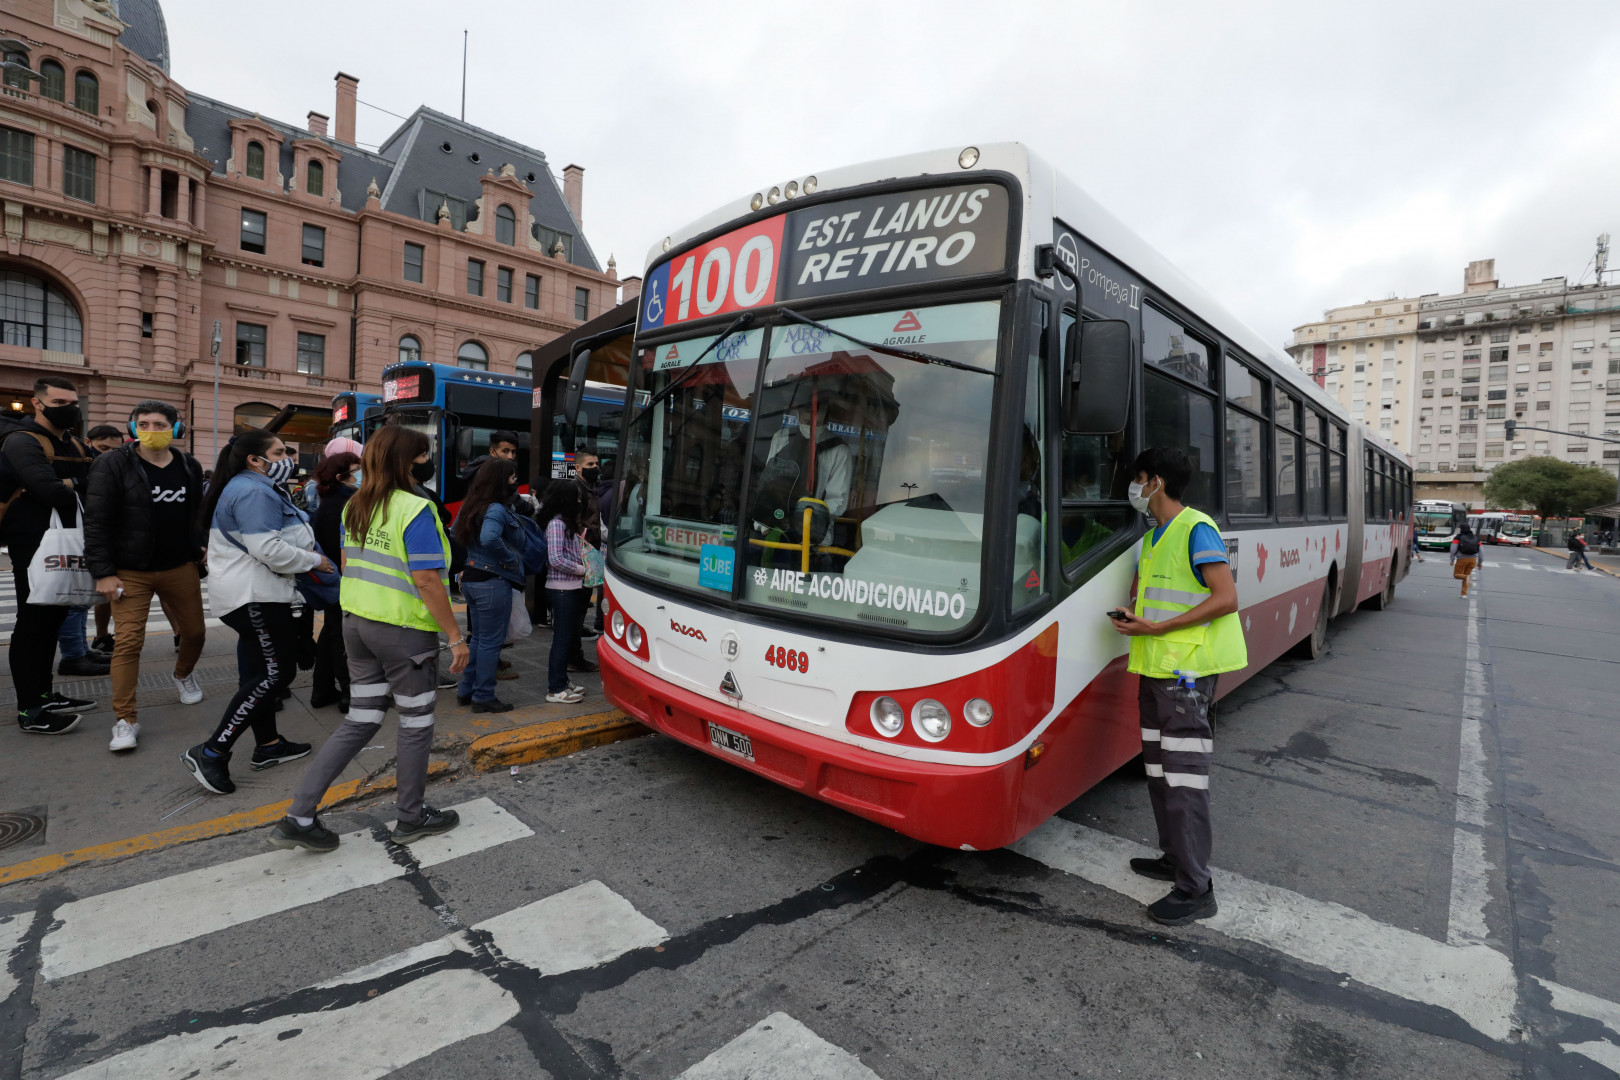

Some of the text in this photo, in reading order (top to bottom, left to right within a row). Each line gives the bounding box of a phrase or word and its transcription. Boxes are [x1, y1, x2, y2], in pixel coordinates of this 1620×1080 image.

[798, 188, 990, 251] EST. LANUS
[797, 230, 977, 285] RETIRO
[671, 235, 774, 321] 100
[1081, 257, 1139, 310] Pompeya II
[784, 324, 833, 343] MEGA
[882, 334, 927, 346] AGRALE
[716, 347, 740, 361] CAR
[791, 339, 823, 354] CAR
[660, 360, 682, 369] AGRALE
[376, 529, 391, 541] DEL
[665, 527, 722, 546] RETIRO
[702, 556, 732, 576] SUBE
[770, 568, 965, 619] AIRE ACONDICIONADO
[256, 628, 272, 647] FILA
[265, 657, 280, 676] FILA
[765, 644, 809, 673] 4869
[236, 695, 258, 716] FILA
[217, 723, 236, 742] FILA
[733, 736, 753, 757] 500
